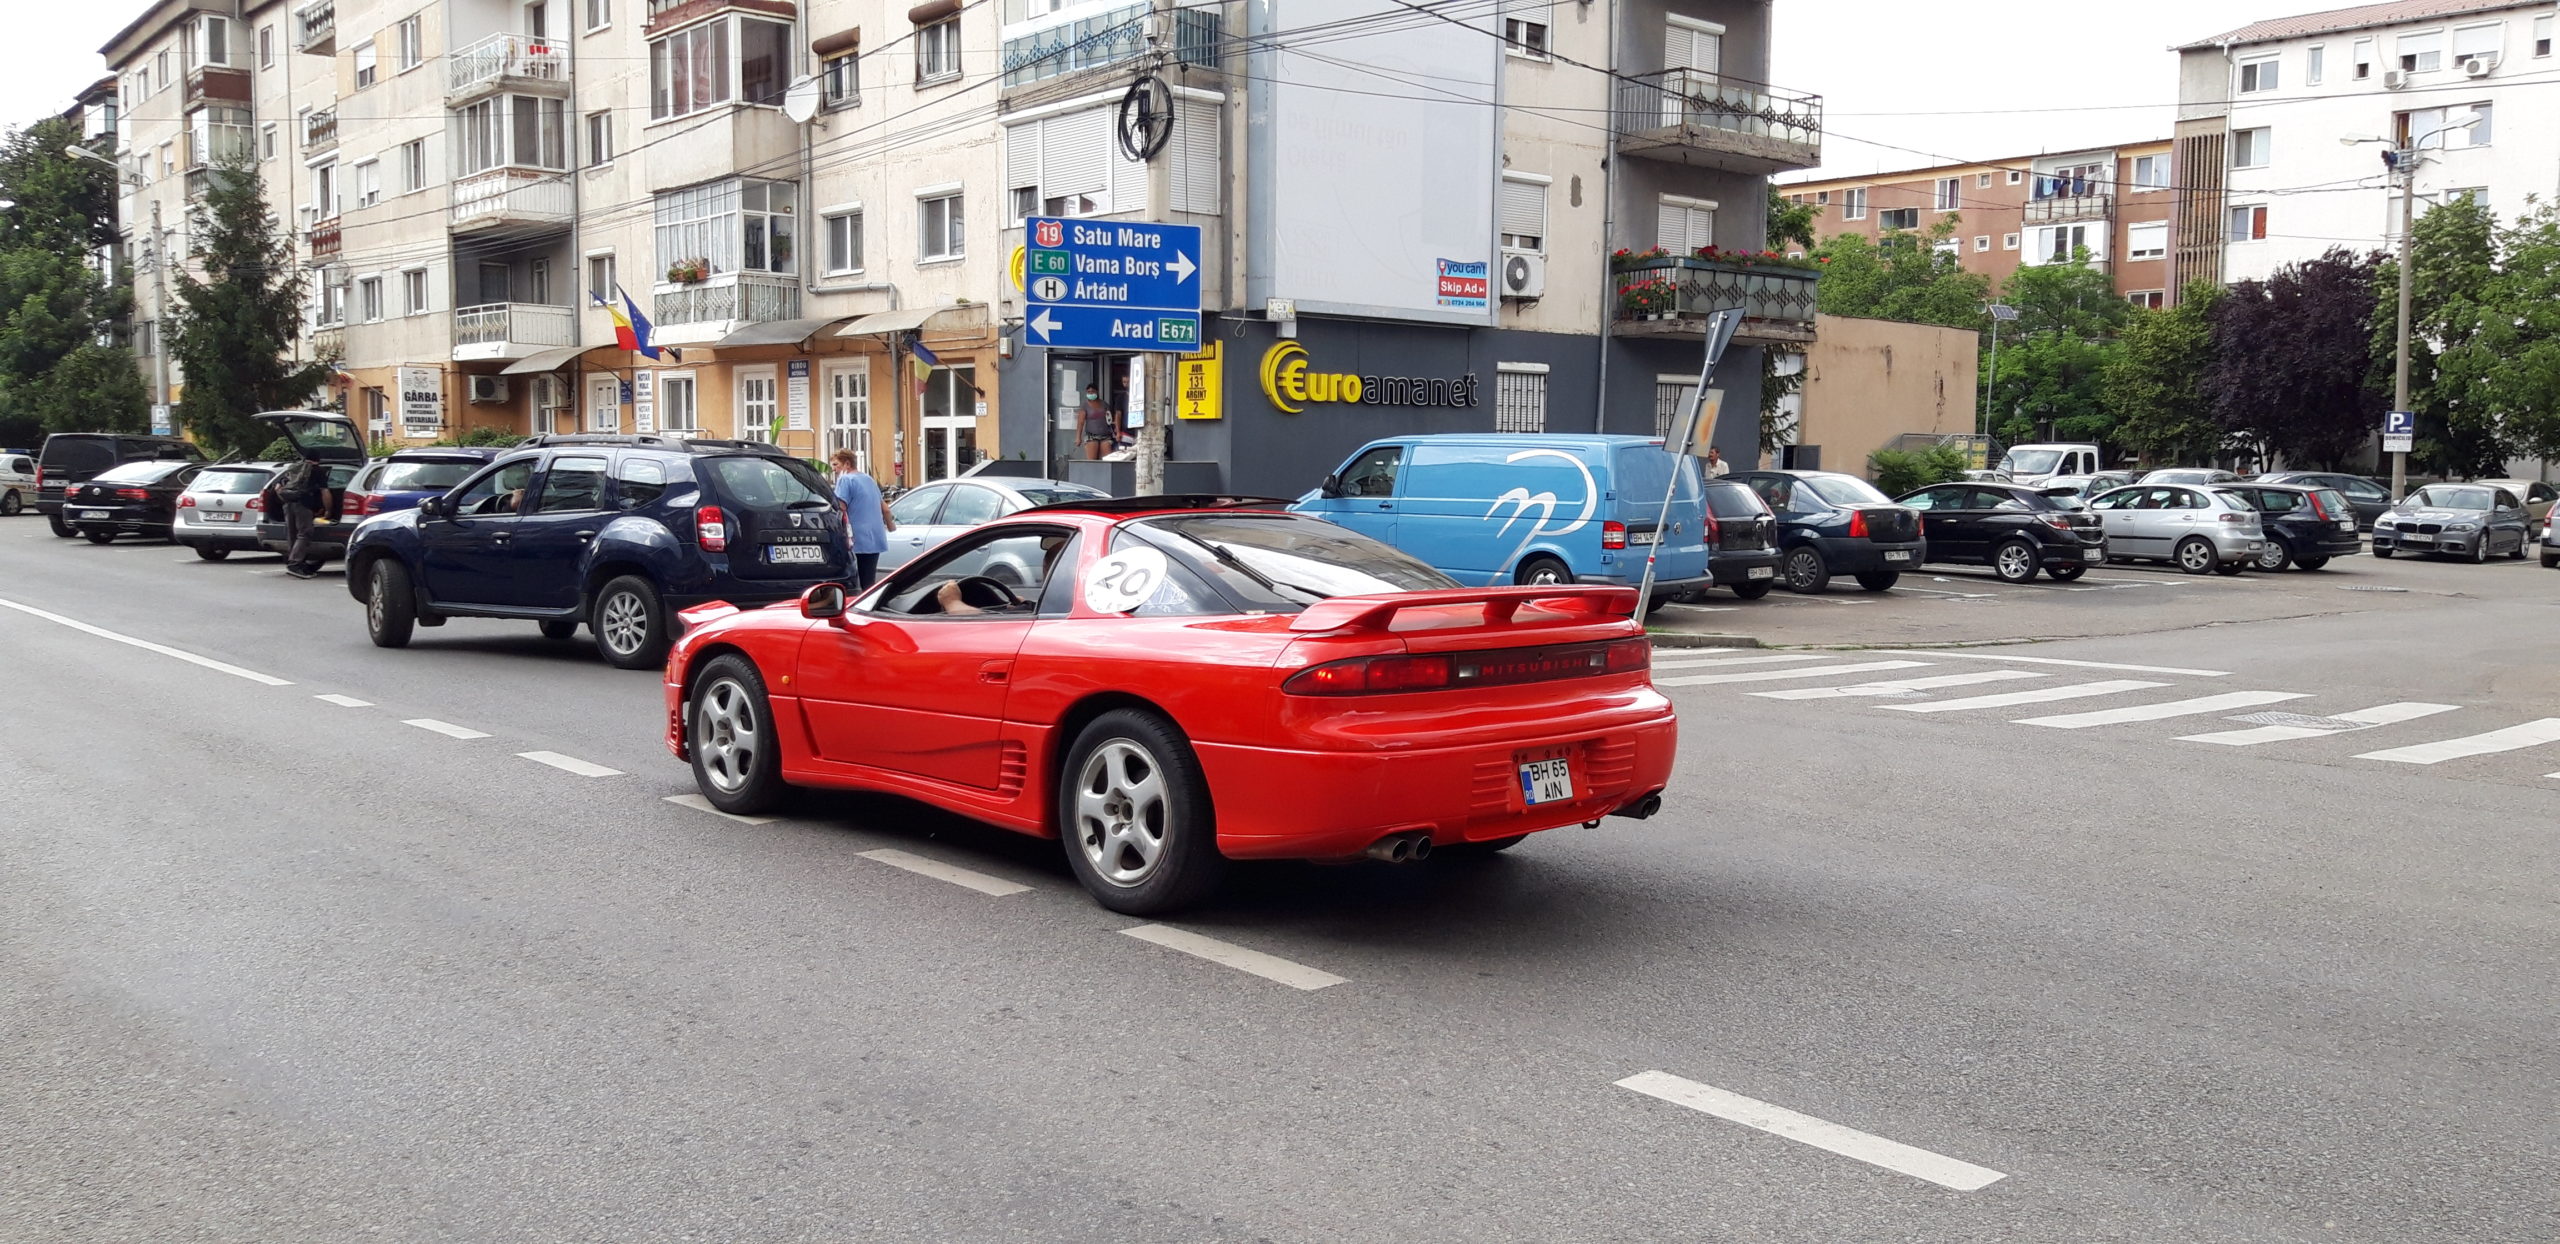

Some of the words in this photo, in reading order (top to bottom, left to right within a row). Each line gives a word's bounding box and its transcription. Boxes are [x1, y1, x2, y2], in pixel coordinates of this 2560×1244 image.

[1041, 226, 1058, 242] 19
[1074, 226, 1111, 246] Satu
[1119, 228, 1161, 248] Mare
[1034, 253, 1044, 269] E
[1049, 257, 1065, 270] 60
[1075, 254, 1119, 274] Vama
[1125, 256, 1160, 279] Borș
[1447, 263, 1464, 275] you
[1465, 263, 1486, 275] can't
[1045, 281, 1056, 298] H
[1075, 277, 1127, 301] Ártánd
[1441, 281, 1462, 294] Skip
[1464, 283, 1477, 293] Ad
[1112, 319, 1153, 338] Arad
[1192, 364, 1203, 373] AUR
[1189, 376, 1204, 387] 131
[404, 389, 438, 402] GÂRBA
[1186, 390, 1207, 399] ARGINT
[1193, 402, 1199, 412] 2
[775, 547, 790, 559] BH
[791, 547, 801, 558] 12
[802, 547, 821, 558] FDO
[1094, 561, 1151, 596] 20
[1482, 658, 1590, 676] MITSUBISHI
[1529, 763, 1551, 781] BH
[1552, 760, 1567, 778] 65
[1545, 781, 1563, 799] AIN
